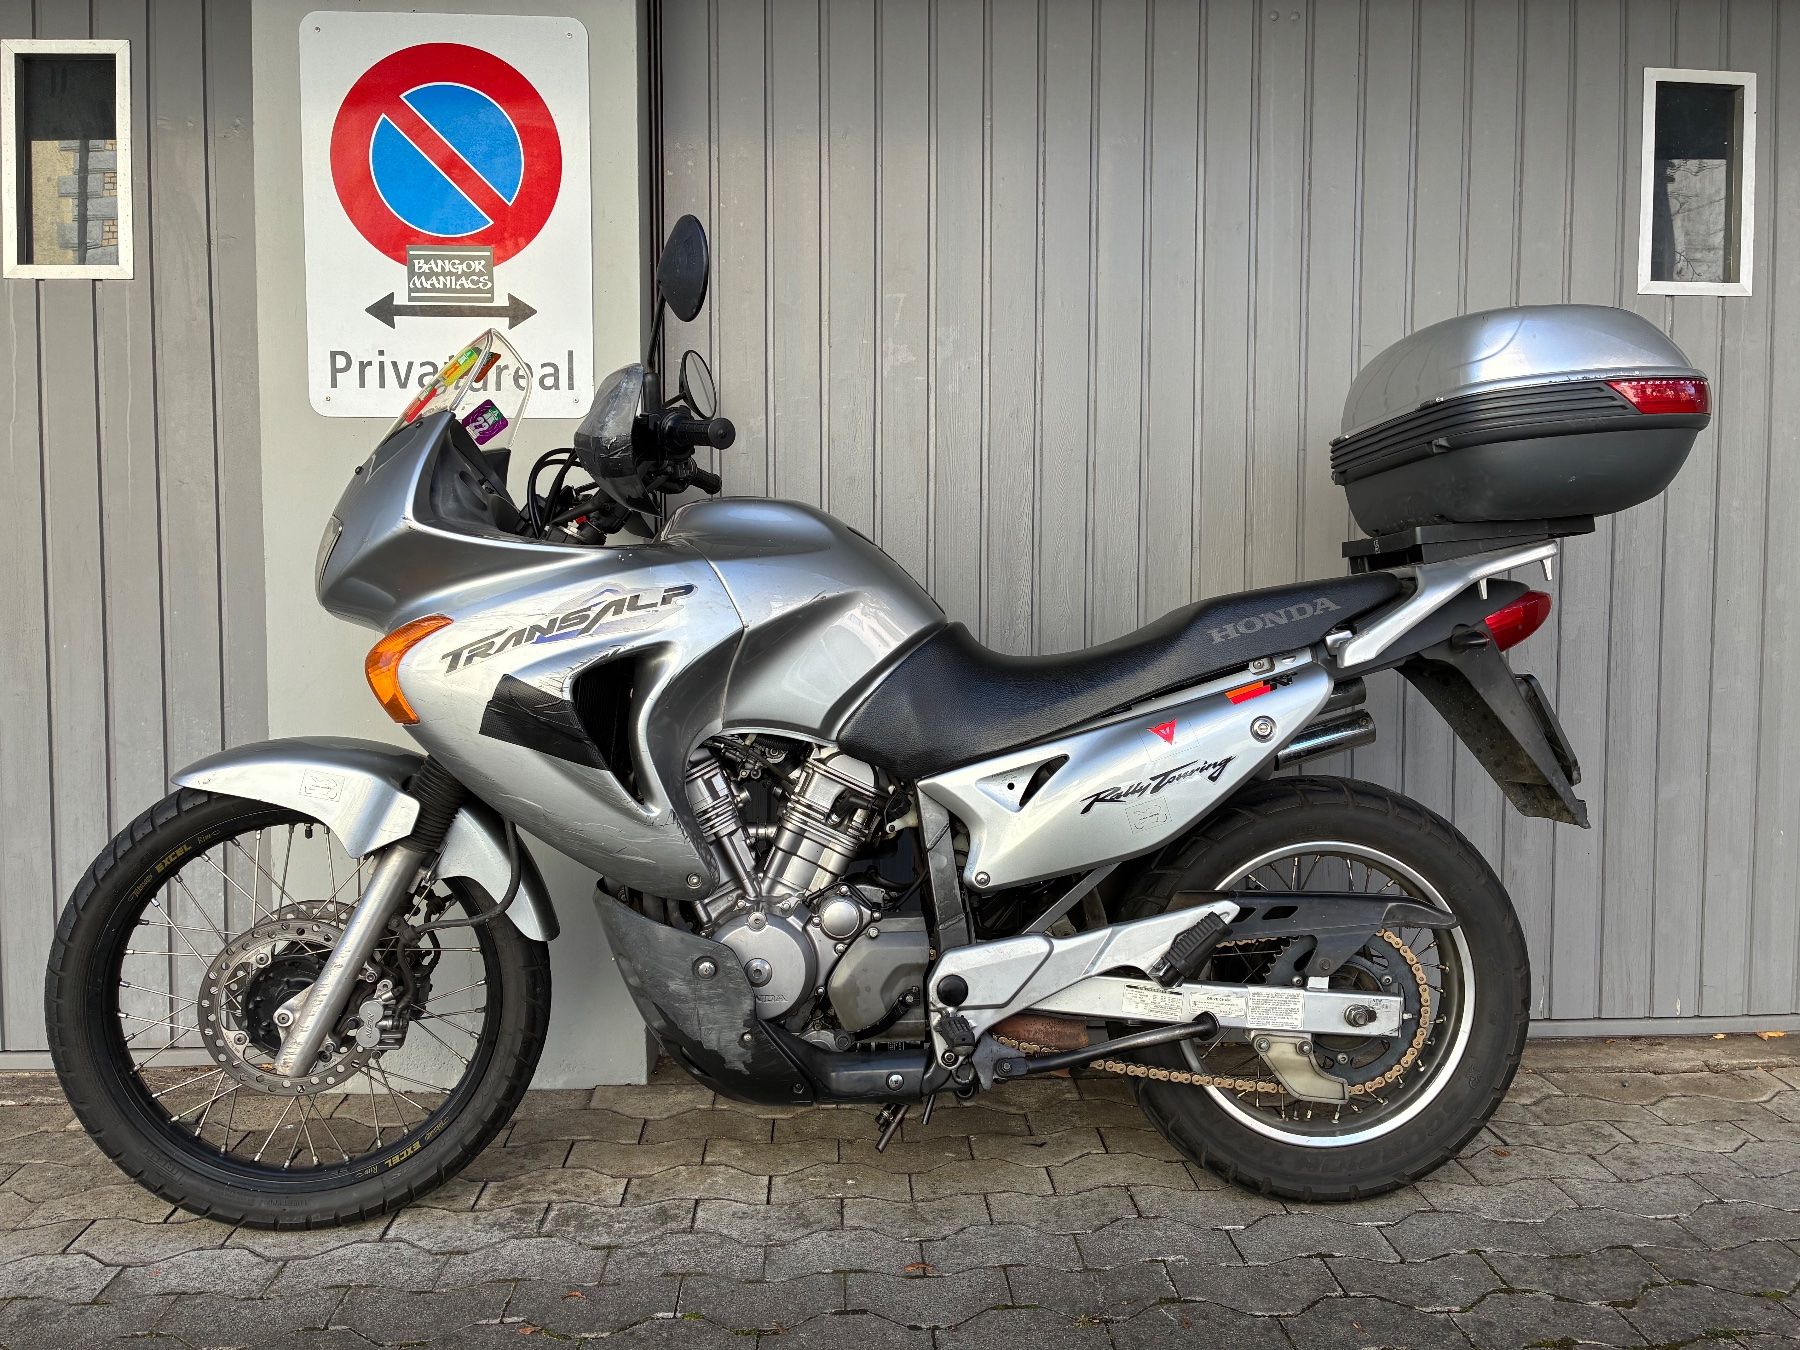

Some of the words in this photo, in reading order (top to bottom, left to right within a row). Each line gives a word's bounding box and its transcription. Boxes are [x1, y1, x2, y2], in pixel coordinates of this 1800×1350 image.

[413, 259, 487, 273] BANGOR
[409, 275, 492, 289] MANIACS
[441, 583, 697, 674] TRANSALP
[1207, 597, 1341, 644] HONDA
[1080, 782, 1151, 814] Rally
[1149, 755, 1238, 794] Touring
[155, 843, 192, 873] EXCEL
[755, 994, 789, 1003] NDA
[384, 1141, 422, 1168] EXCEL
